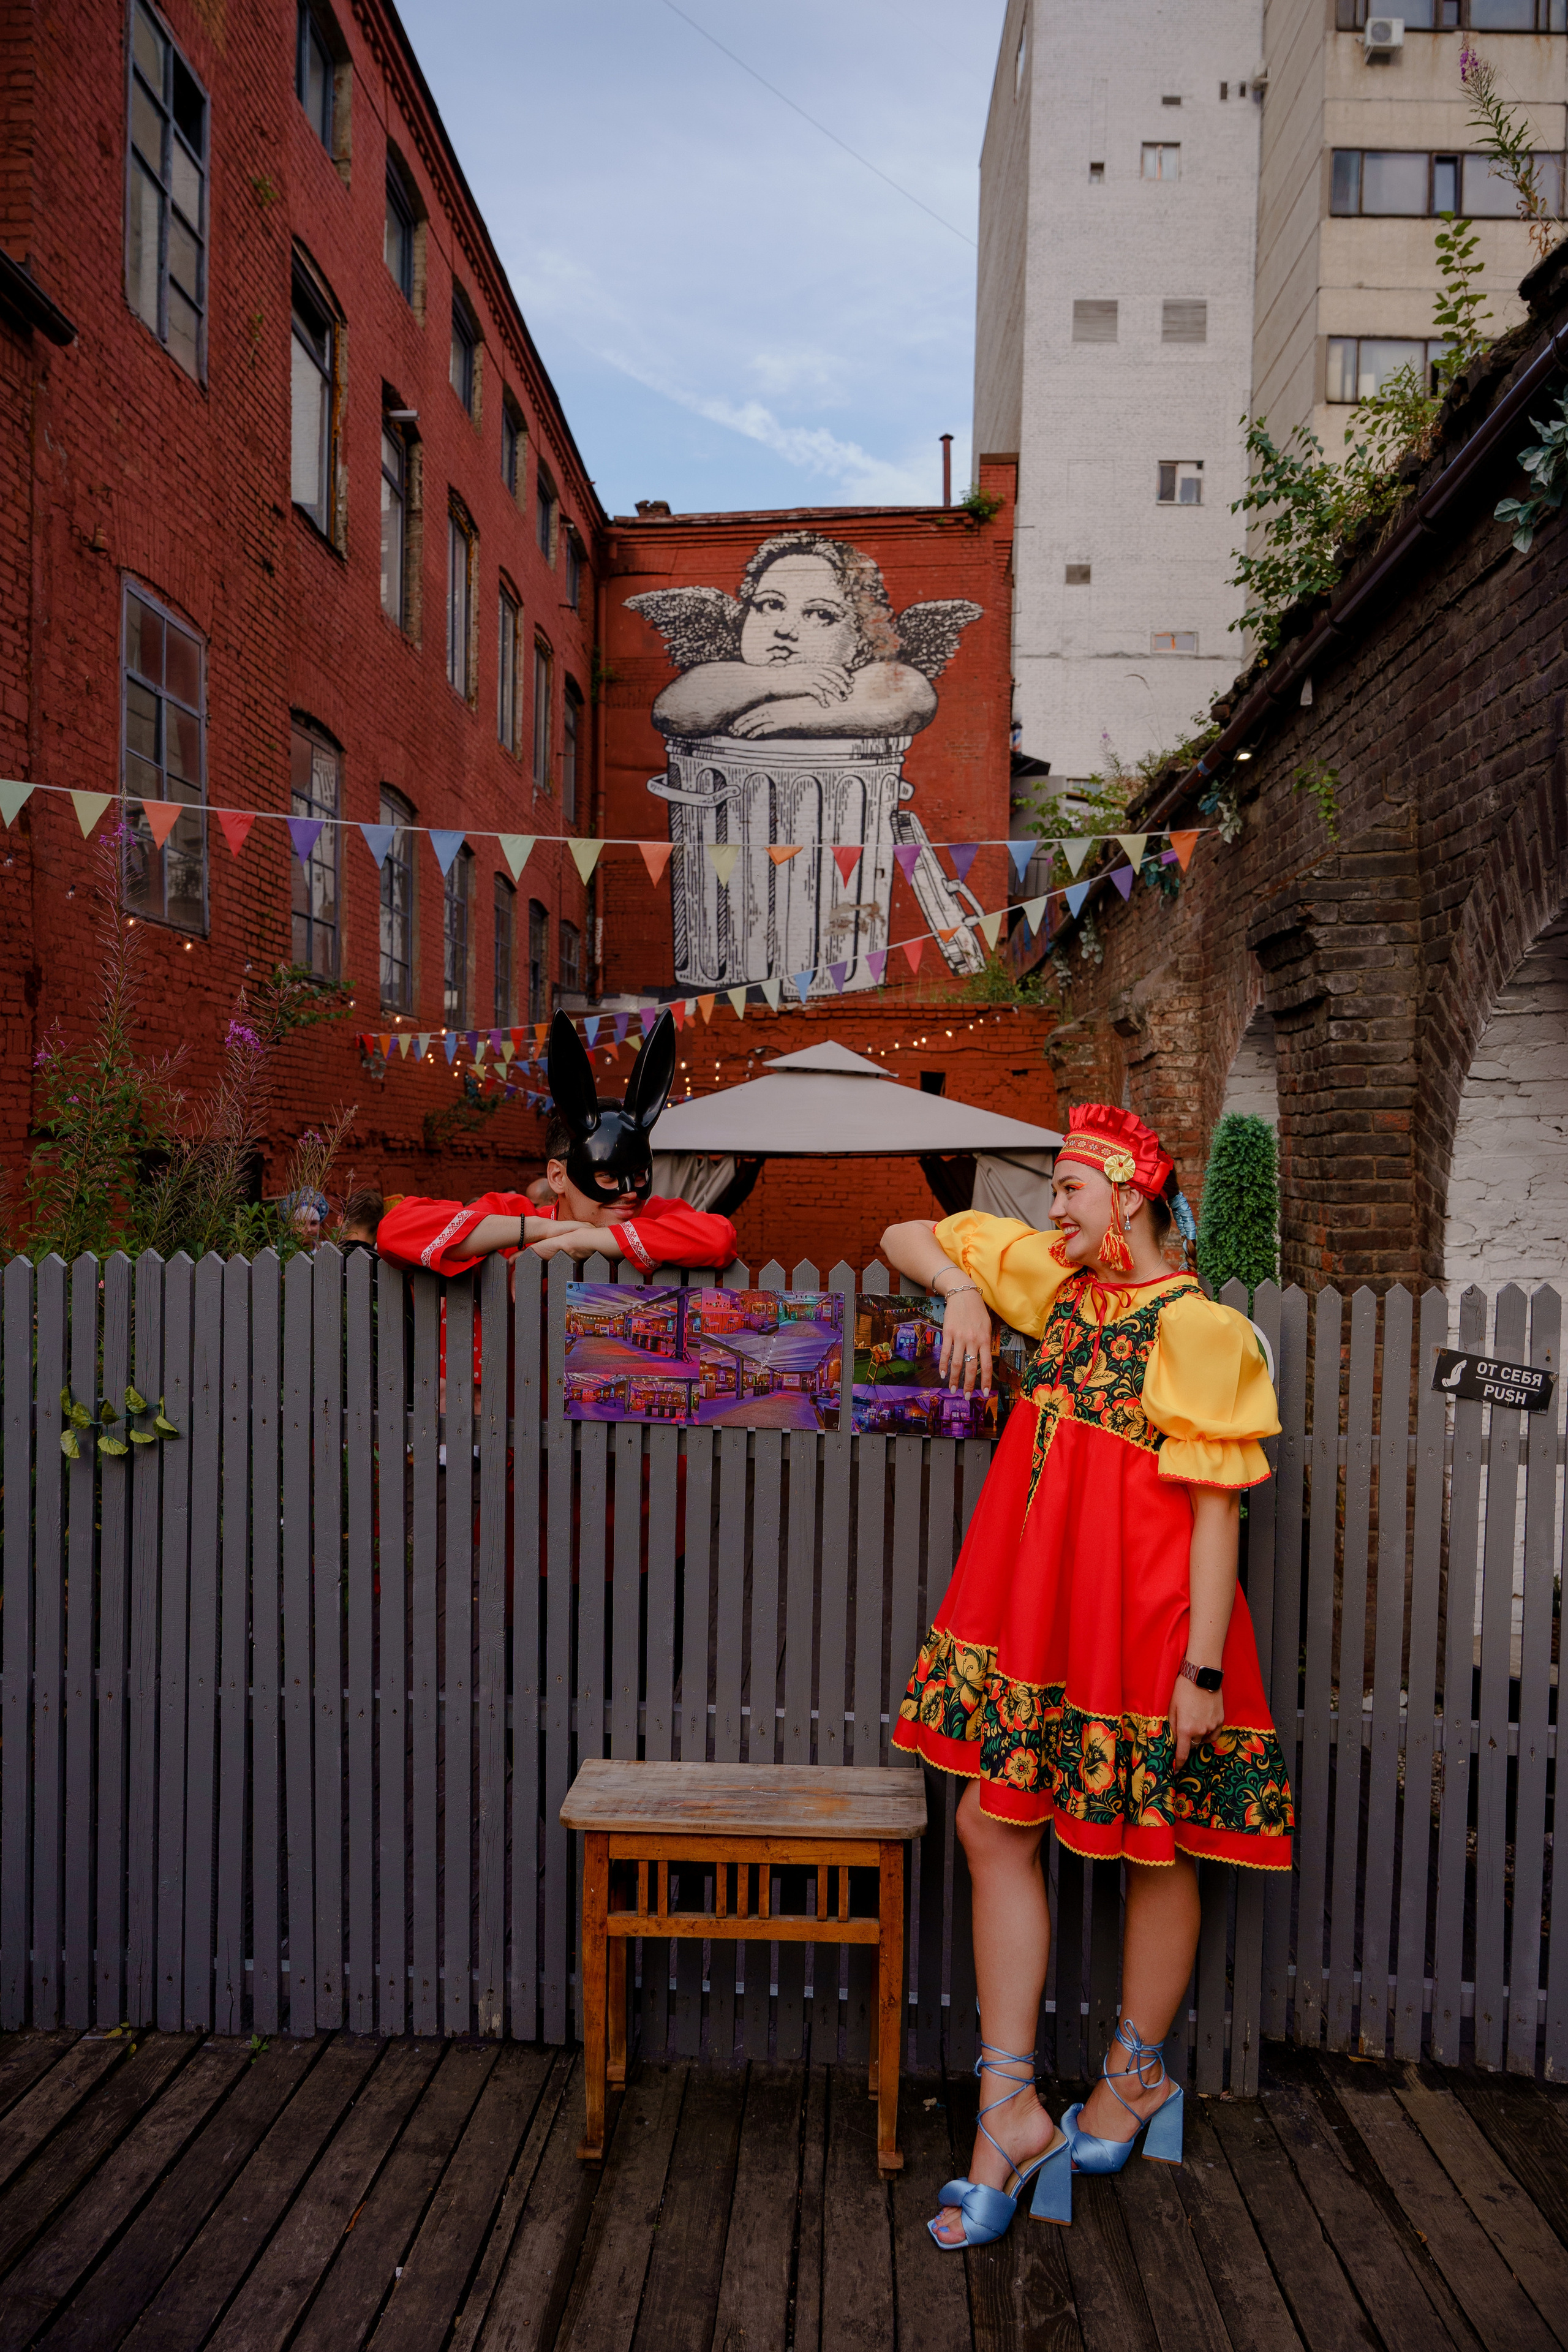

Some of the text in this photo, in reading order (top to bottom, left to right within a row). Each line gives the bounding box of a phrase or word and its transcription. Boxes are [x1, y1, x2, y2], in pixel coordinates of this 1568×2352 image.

[1477, 1362, 1543, 1387] ОТ СЕБЯ
[1483, 1384, 1527, 1405] PUSH
